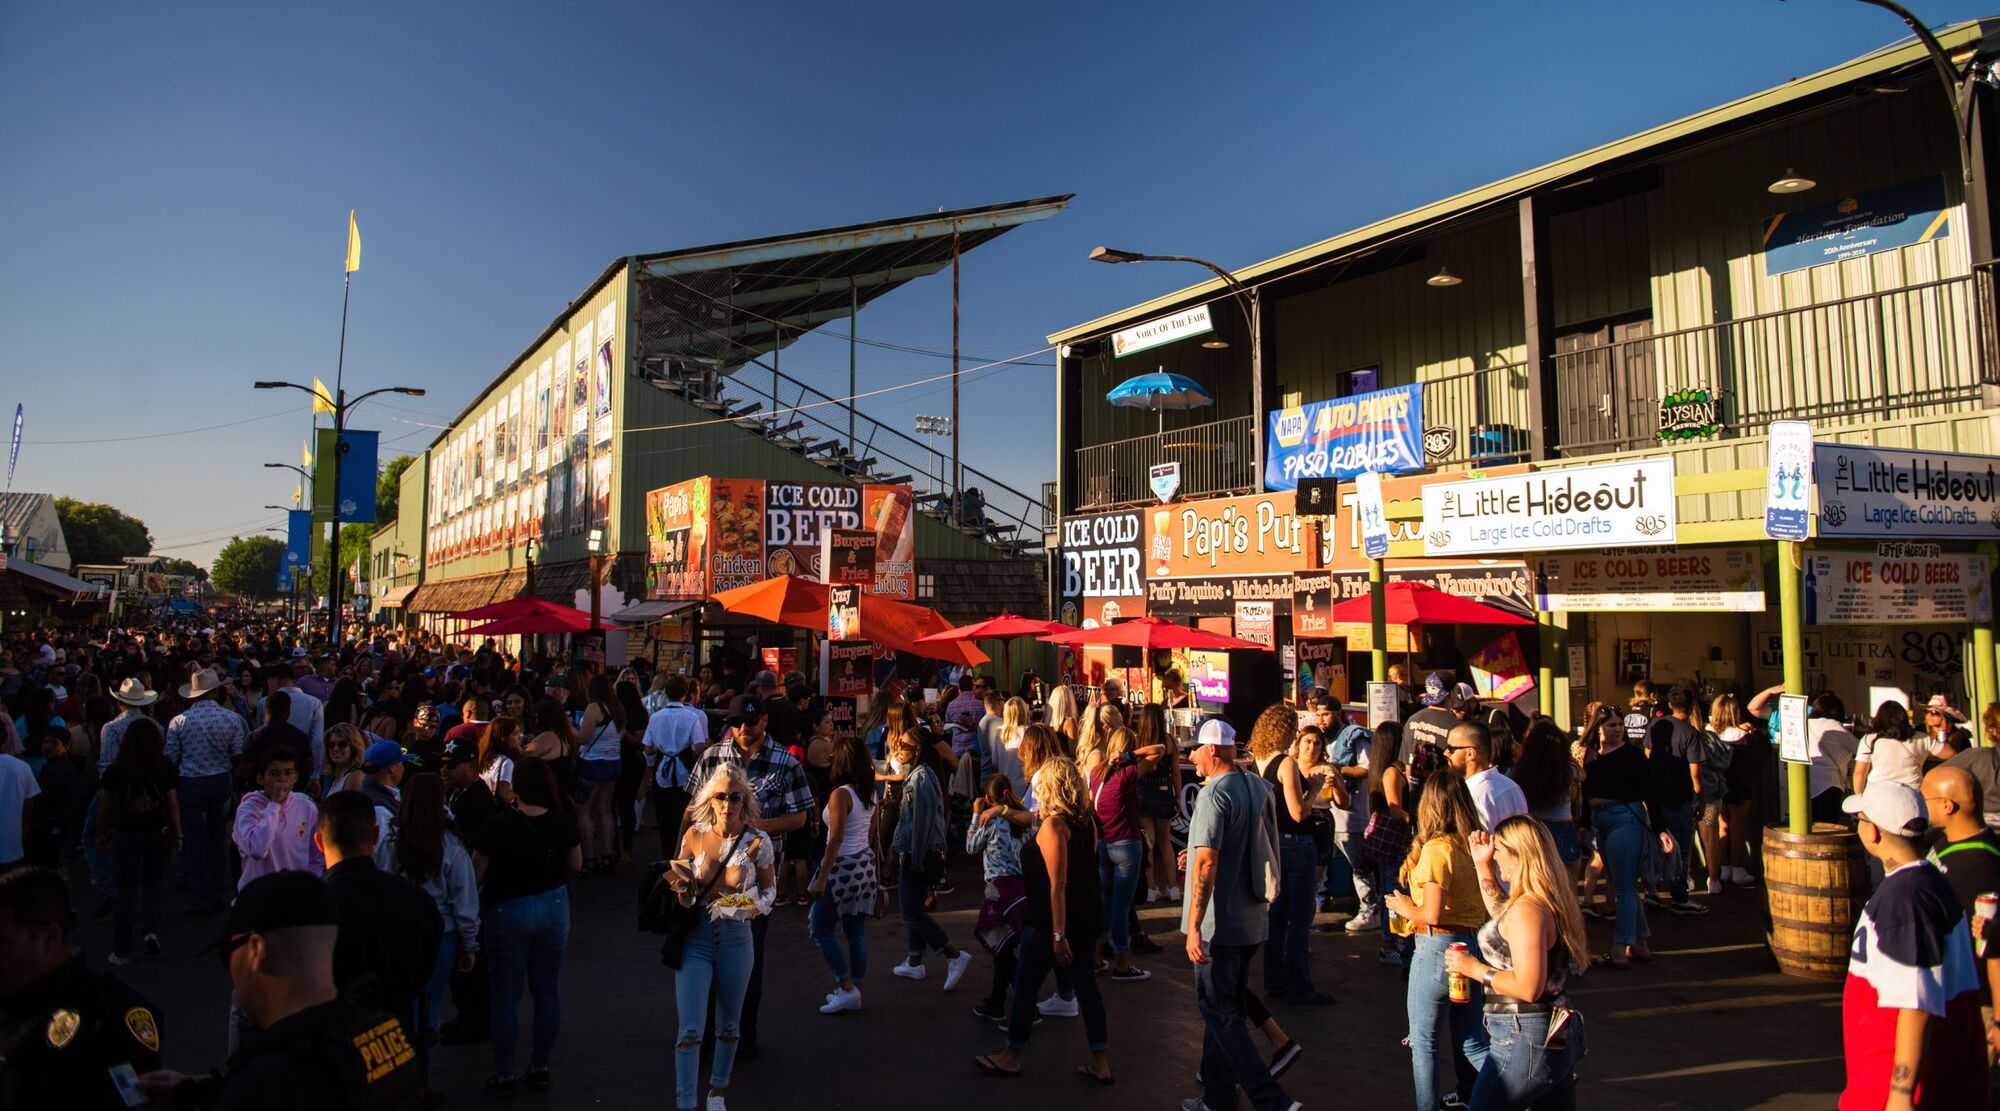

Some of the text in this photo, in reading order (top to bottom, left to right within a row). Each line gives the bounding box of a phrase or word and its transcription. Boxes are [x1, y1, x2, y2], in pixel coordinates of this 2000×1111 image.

[1795, 211, 1905, 244] Heritage Foundation
[1823, 238, 1877, 255] 20th Anniversary
[1313, 392, 1409, 433] AUTO PARTS
[1658, 402, 1715, 430] ELYSIAN
[1279, 416, 1302, 437] NAPA
[1672, 422, 1701, 431] BREWING
[1424, 432, 1450, 450] 805
[1283, 438, 1400, 480] PASO ROBLES
[1835, 455, 1849, 495] The
[1851, 461, 1909, 494] Little
[1912, 458, 1995, 503] Hideout
[663, 487, 688, 523] Papi's
[770, 485, 859, 507] ICE COLD
[1442, 490, 1455, 522] The
[1458, 488, 1520, 519] Little
[1526, 469, 1647, 517] Hideout
[1635, 514, 1667, 532] 805
[1823, 504, 1847, 523] 805
[1864, 503, 1897, 529] Large
[1900, 504, 1917, 524] Ice
[1920, 504, 1943, 524] Cold
[1945, 505, 1977, 525] Drafts
[833, 533, 876, 549] Burgers
[1064, 514, 1140, 547] ICE COLD
[1182, 505, 1249, 568] Papi's
[1429, 530, 1452, 545] 805
[1470, 515, 1612, 545] Large Ice Cold Drafts
[711, 553, 762, 575] Chicken
[847, 550, 857, 564] &
[1573, 560, 1598, 578] ICE
[1604, 558, 1649, 578] COLD
[1656, 556, 1712, 577] BEERS
[840, 566, 870, 581] Fries
[1063, 547, 1144, 598] BEER
[1846, 561, 1873, 584] ICE
[1880, 561, 1920, 584] COLD
[1925, 561, 1959, 584] BEERS
[831, 588, 851, 604] Crazy
[873, 574, 908, 597] Hot Dog
[1149, 579, 1292, 604] Puffy Taquitos Michelada
[1294, 576, 1331, 594] Burgers
[1341, 576, 1371, 598] Frie
[1436, 571, 1527, 602] Vampiro's
[1243, 606, 1266, 616] FROZEN
[1305, 594, 1314, 611] &
[1301, 614, 1327, 631] Fries
[831, 645, 873, 660] Burgers
[1299, 642, 1333, 661] Crazy
[1828, 642, 1896, 659] ULTRA
[845, 661, 854, 674] &
[839, 677, 867, 691] Fries
[360, 1027, 411, 1072] POLICE
